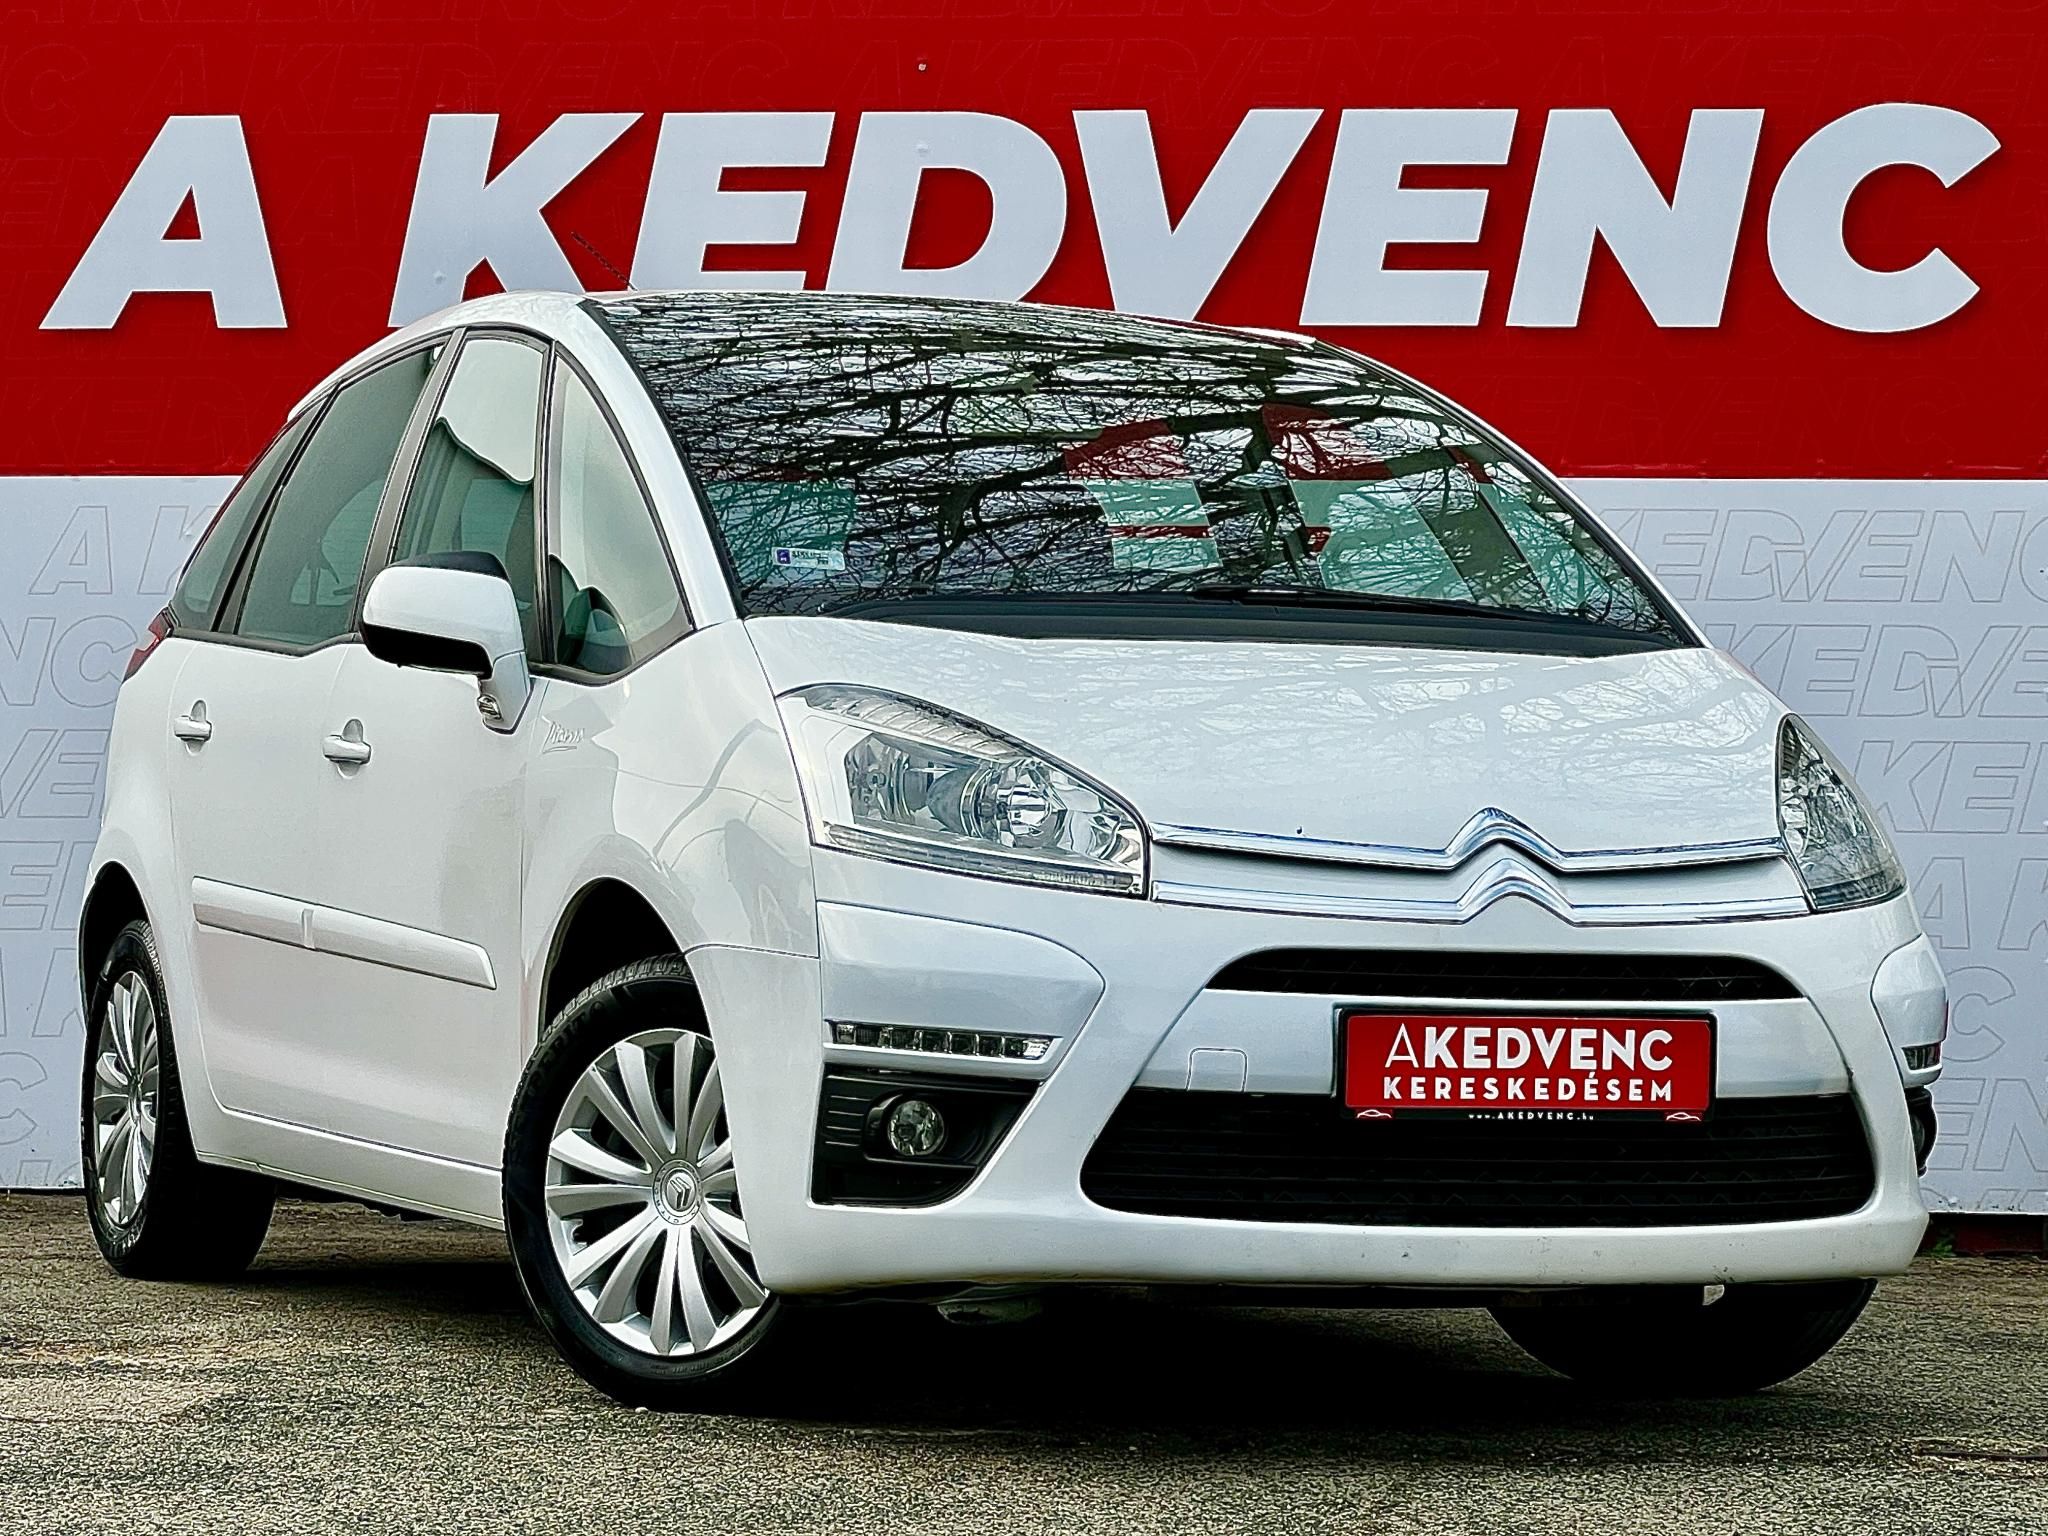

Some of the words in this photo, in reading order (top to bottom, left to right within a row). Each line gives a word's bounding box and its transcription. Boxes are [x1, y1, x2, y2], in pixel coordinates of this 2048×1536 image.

[39, 115, 288, 329] A
[387, 103, 2001, 333] KEDVENC
[1382, 1072, 1673, 1102] KERESKEDÉSEM
[1468, 1111, 1594, 1121] www.AKEDVENC.hu
